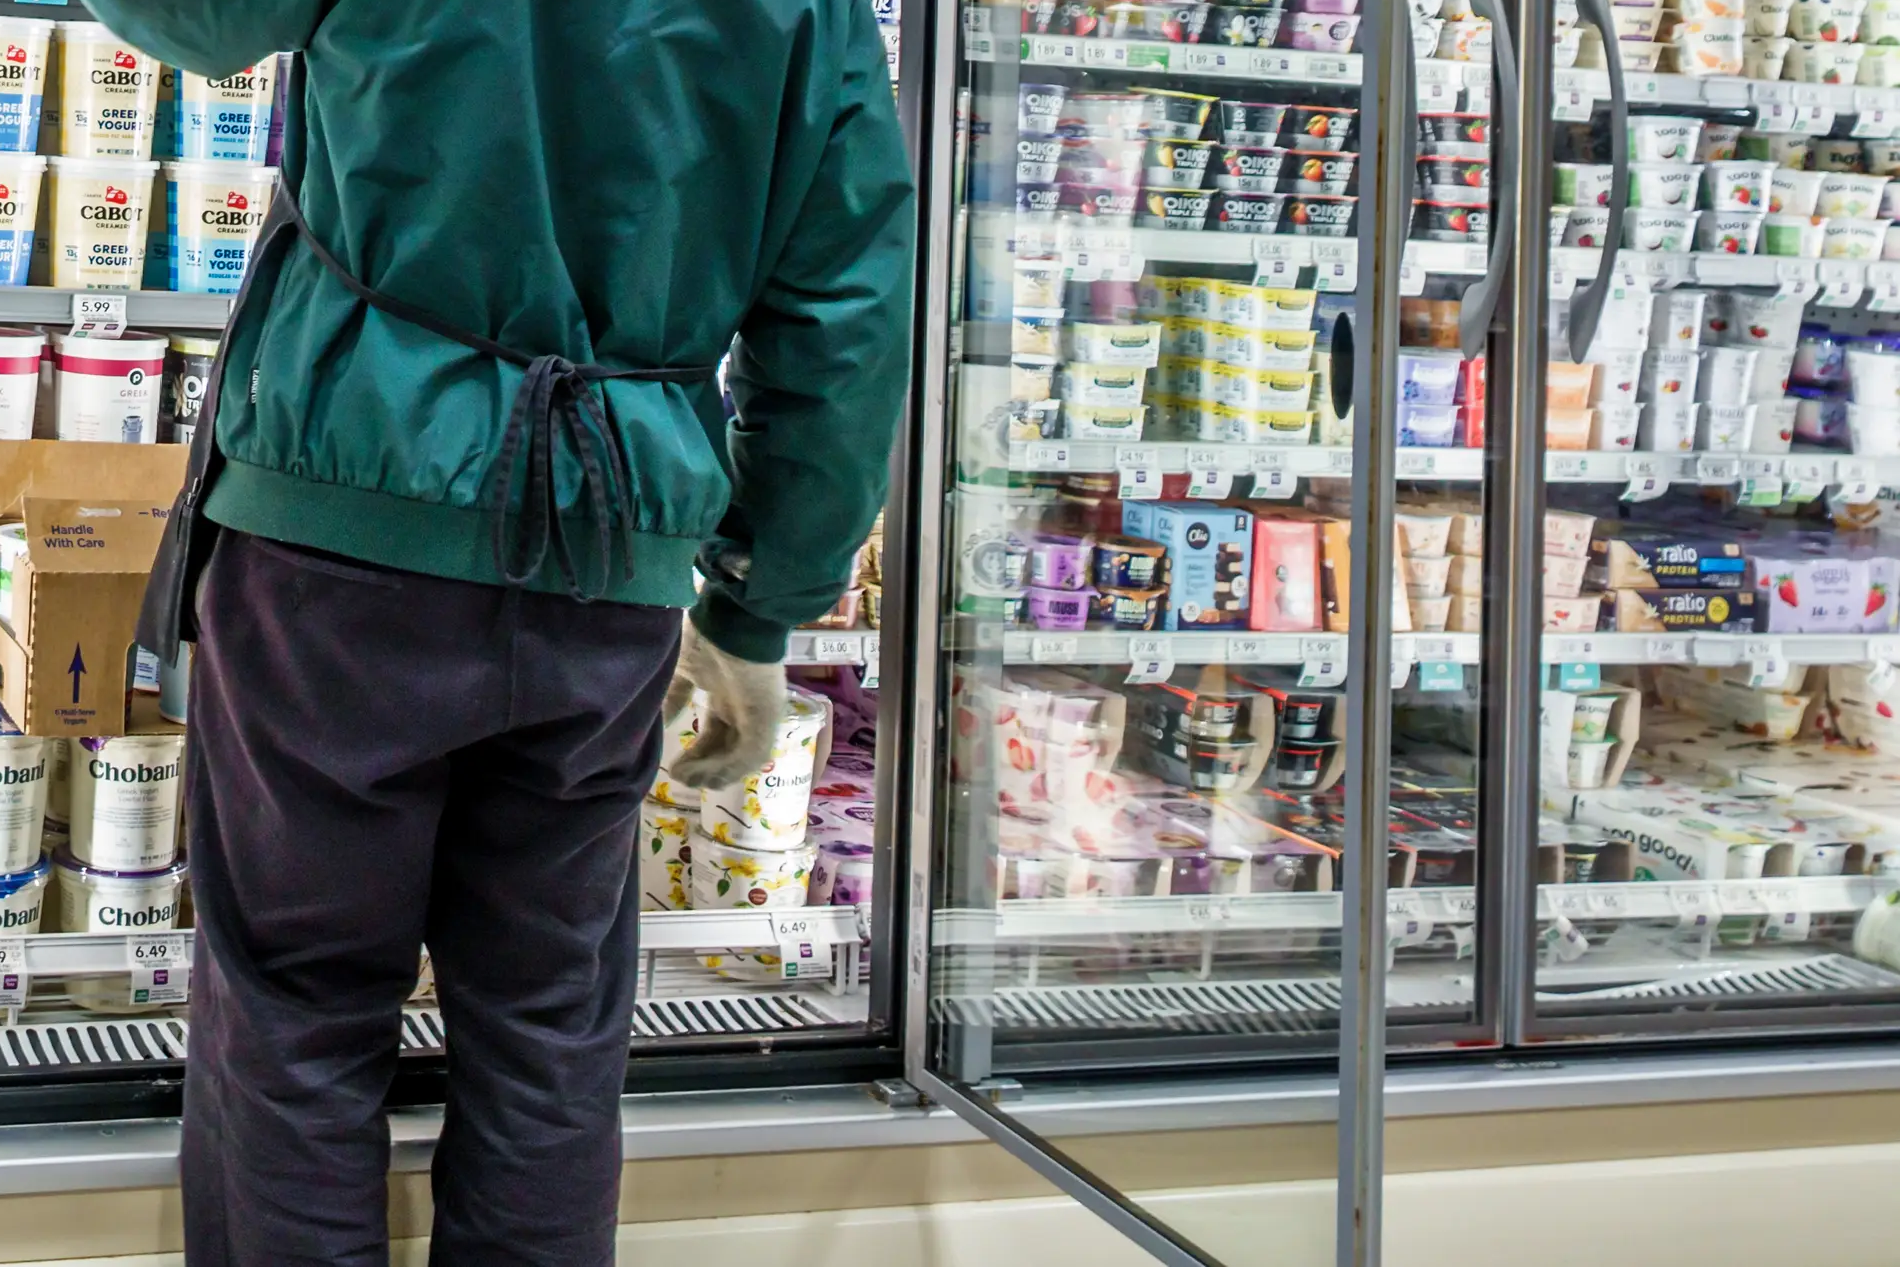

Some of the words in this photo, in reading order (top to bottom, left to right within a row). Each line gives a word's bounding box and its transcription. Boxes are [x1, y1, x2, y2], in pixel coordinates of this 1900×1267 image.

[97, 120, 142, 131] YOGURT
[1224, 200, 1275, 214] OIKOS
[80, 300, 111, 315] 5.99
[119, 388, 149, 399] GREEK
[50, 524, 94, 535] Handle
[44, 537, 74, 549] With
[76, 537, 105, 549] Care
[1661, 544, 1698, 563] ratio
[1656, 564, 1698, 575] PROTEIN
[1668, 592, 1706, 612] ratio
[1663, 612, 1706, 624] PROTEIN
[822, 641, 848, 654] 3/6.00
[89, 757, 180, 783] Chobani
[1639, 834, 1692, 871] good
[780, 921, 807, 934] 6.49
[135, 943, 168, 959] 6.49
